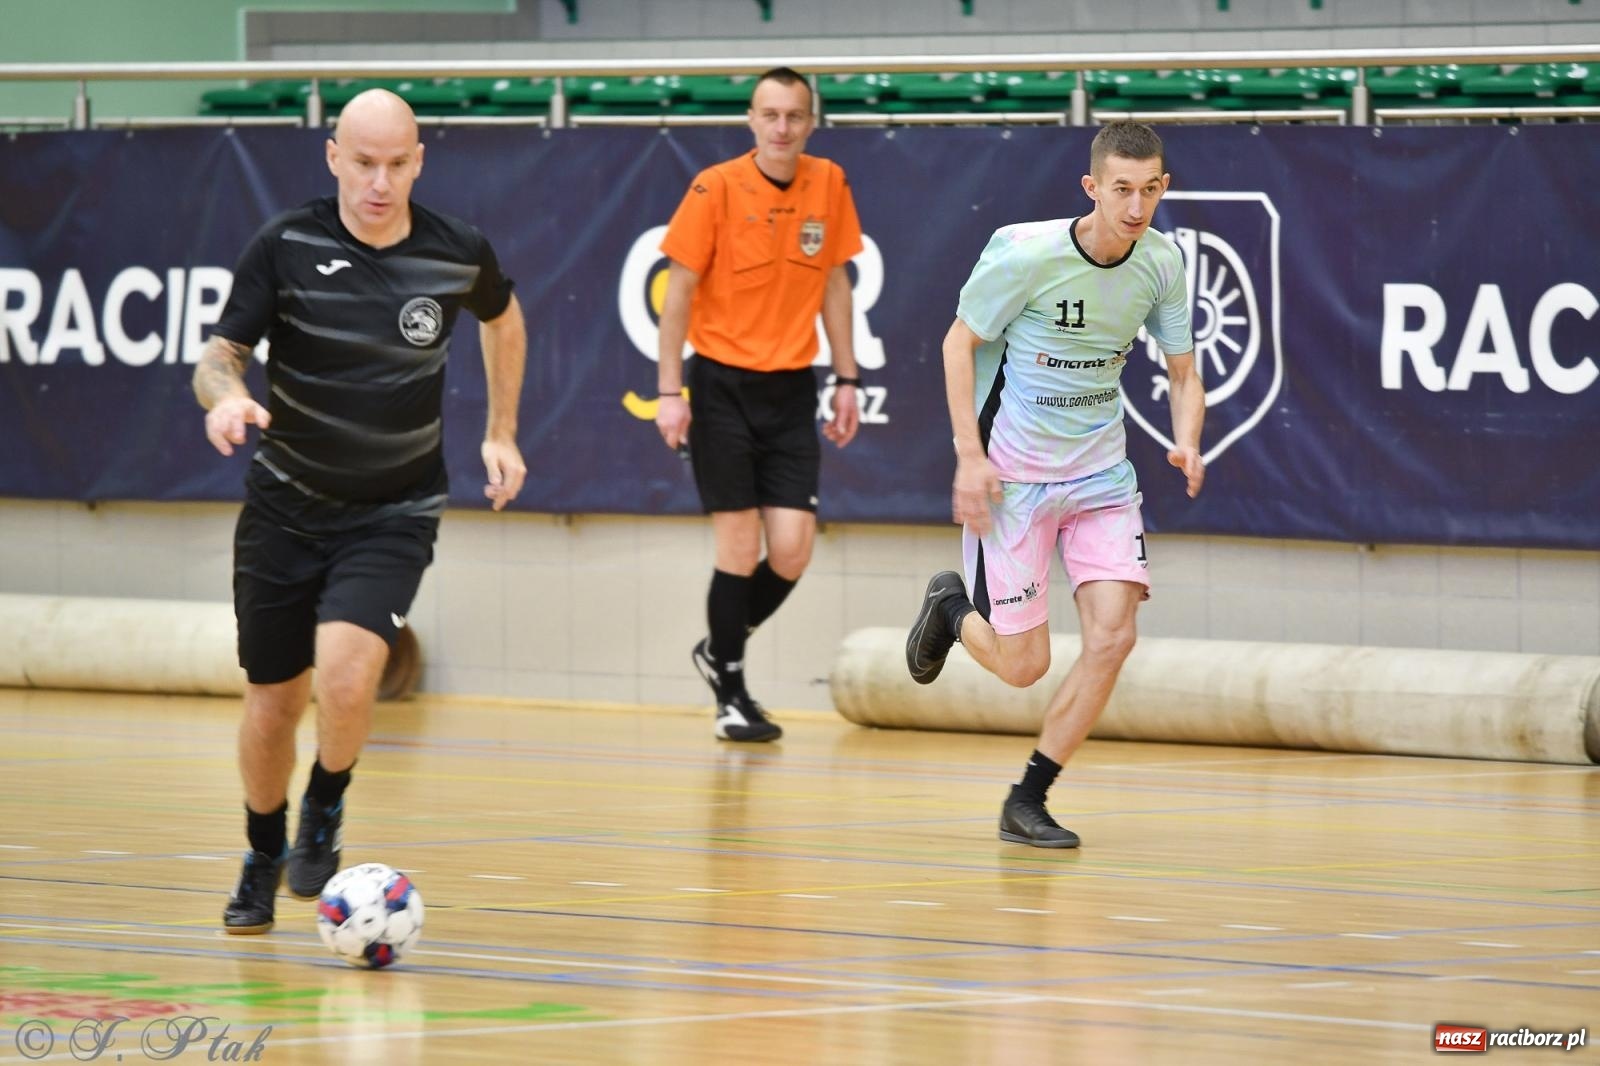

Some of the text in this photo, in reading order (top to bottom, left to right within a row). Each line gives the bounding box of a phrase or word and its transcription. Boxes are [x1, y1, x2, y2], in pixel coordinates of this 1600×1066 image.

[0, 266, 269, 367] RACIB
[1055, 300, 1085, 328] 11
[1381, 282, 1600, 394] RAC
[1036, 352, 1106, 369] Concrete
